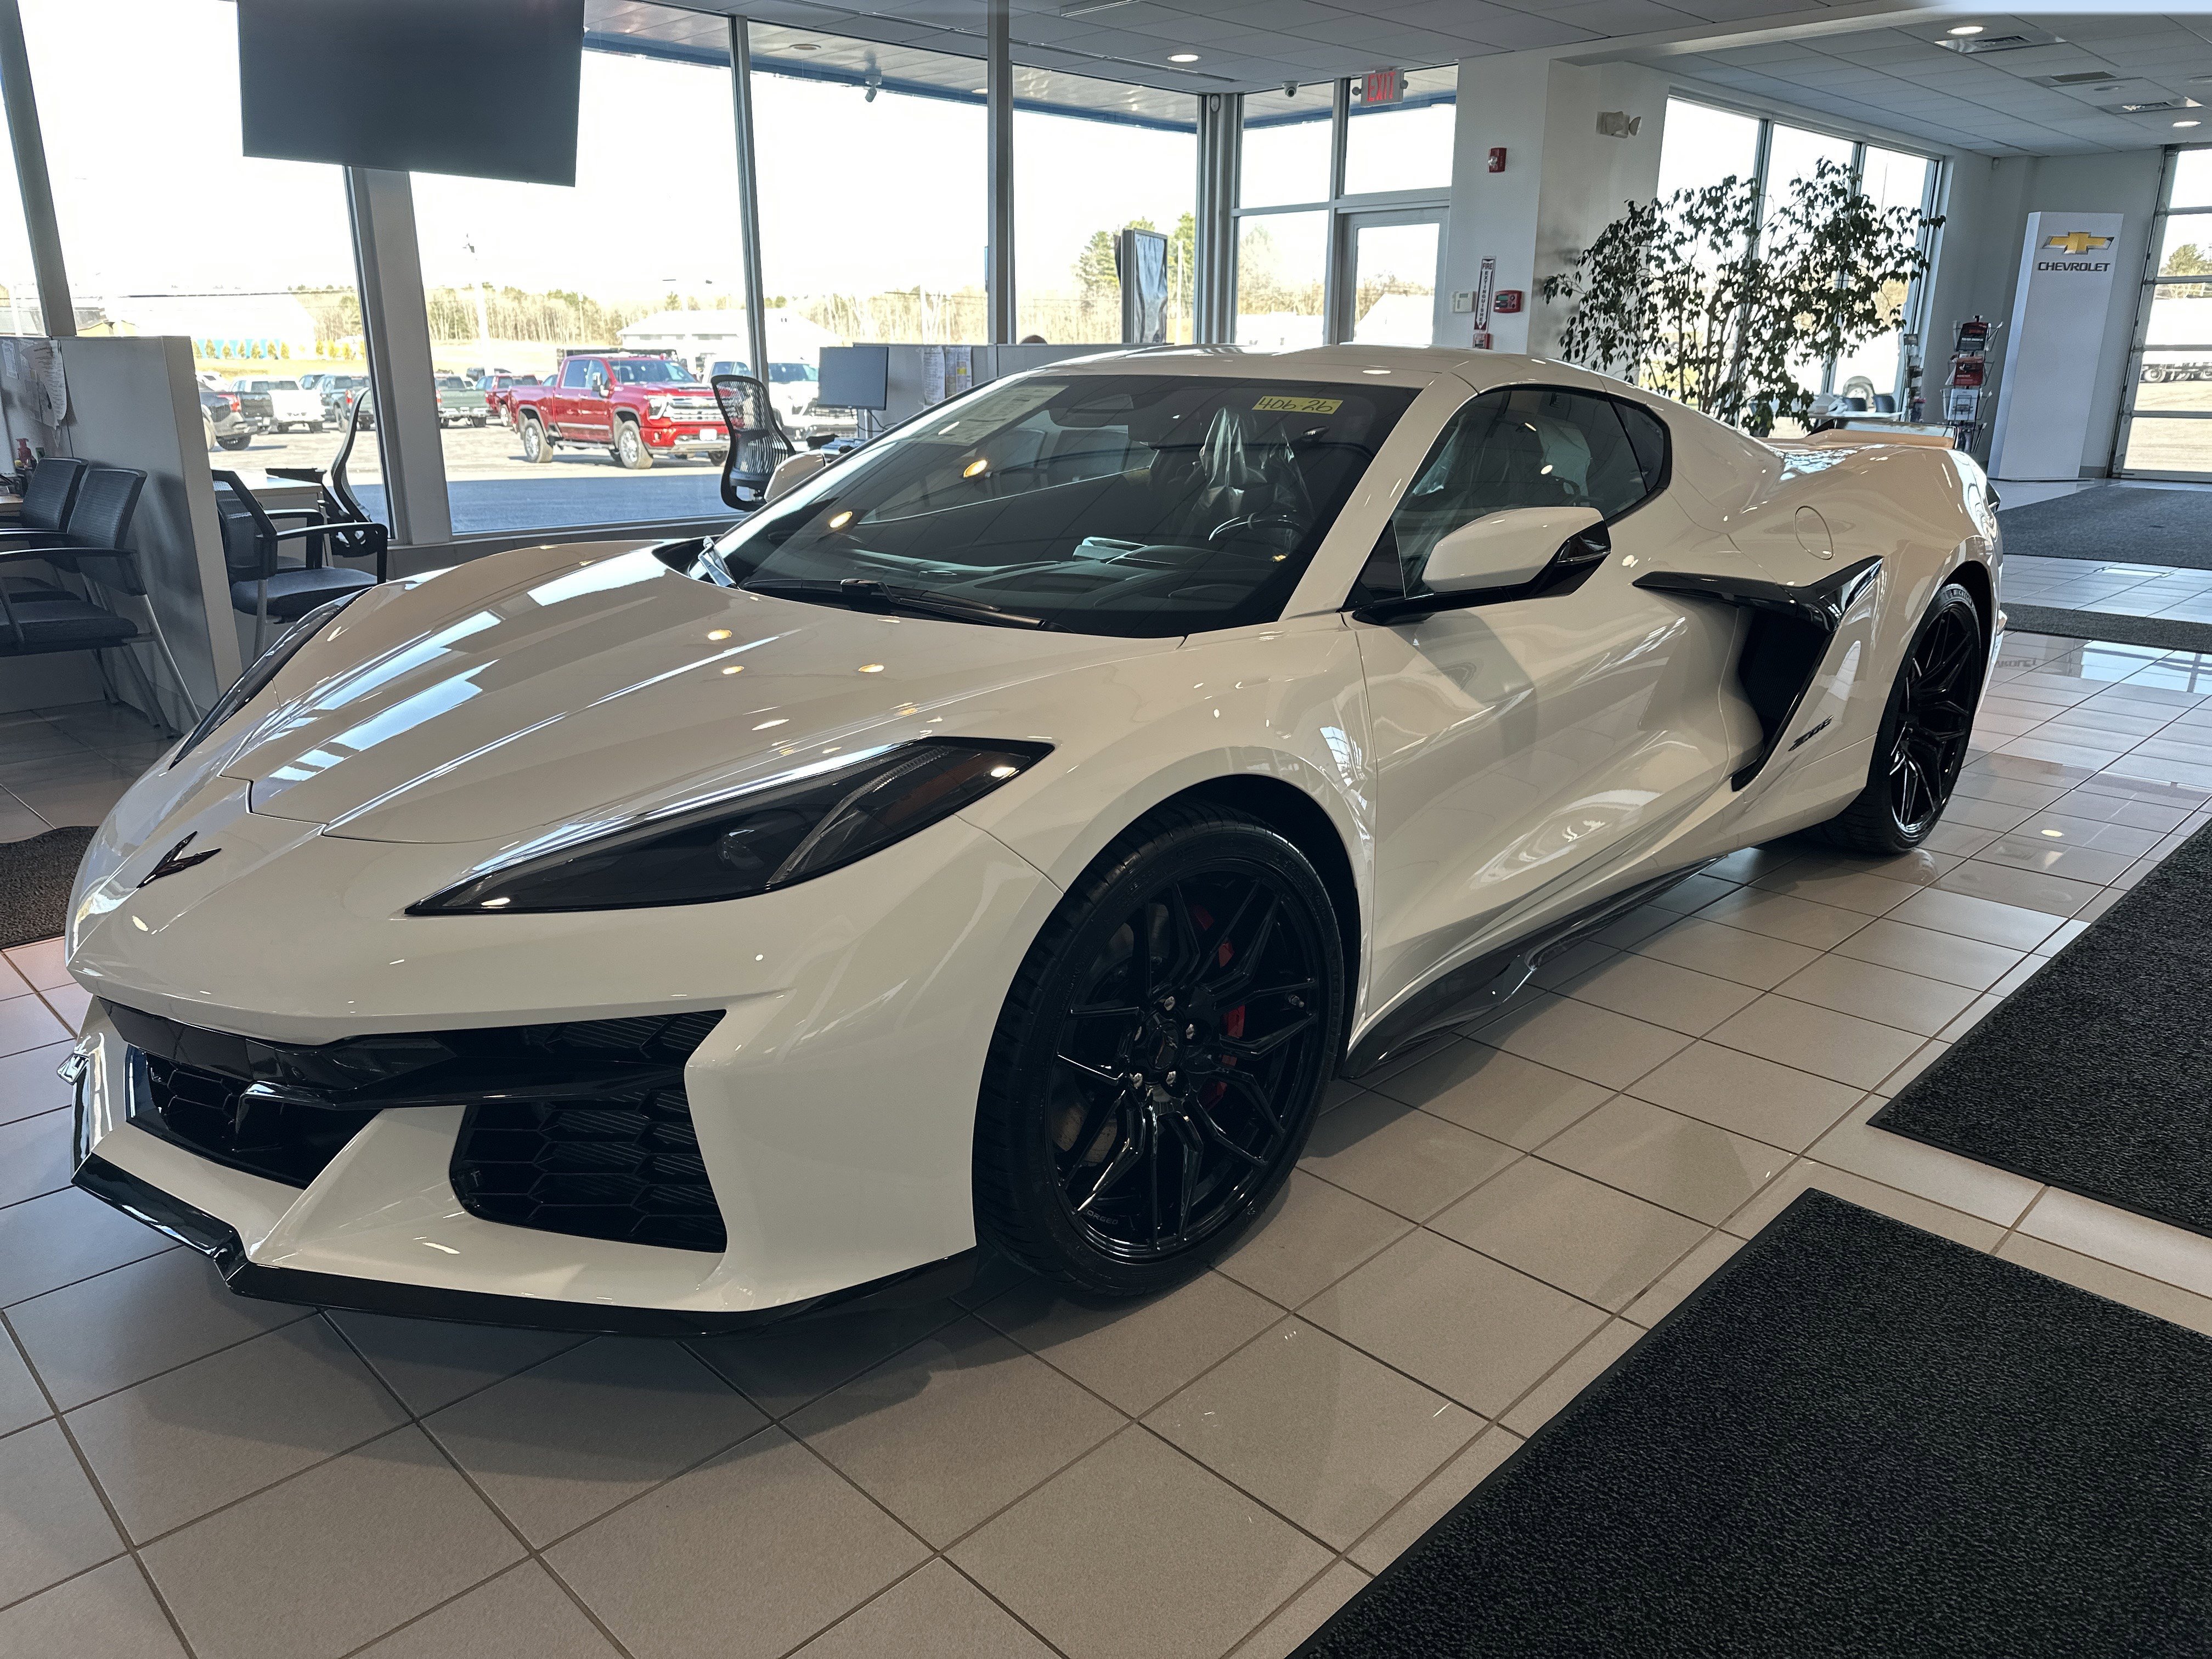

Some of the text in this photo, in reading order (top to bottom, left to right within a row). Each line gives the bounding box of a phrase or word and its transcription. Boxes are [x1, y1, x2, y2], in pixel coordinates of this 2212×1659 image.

[1367, 71, 1396, 102] EXIT
[2038, 262, 2111, 272] CHEVROLET
[1084, 1209, 1119, 1225] ORGED
